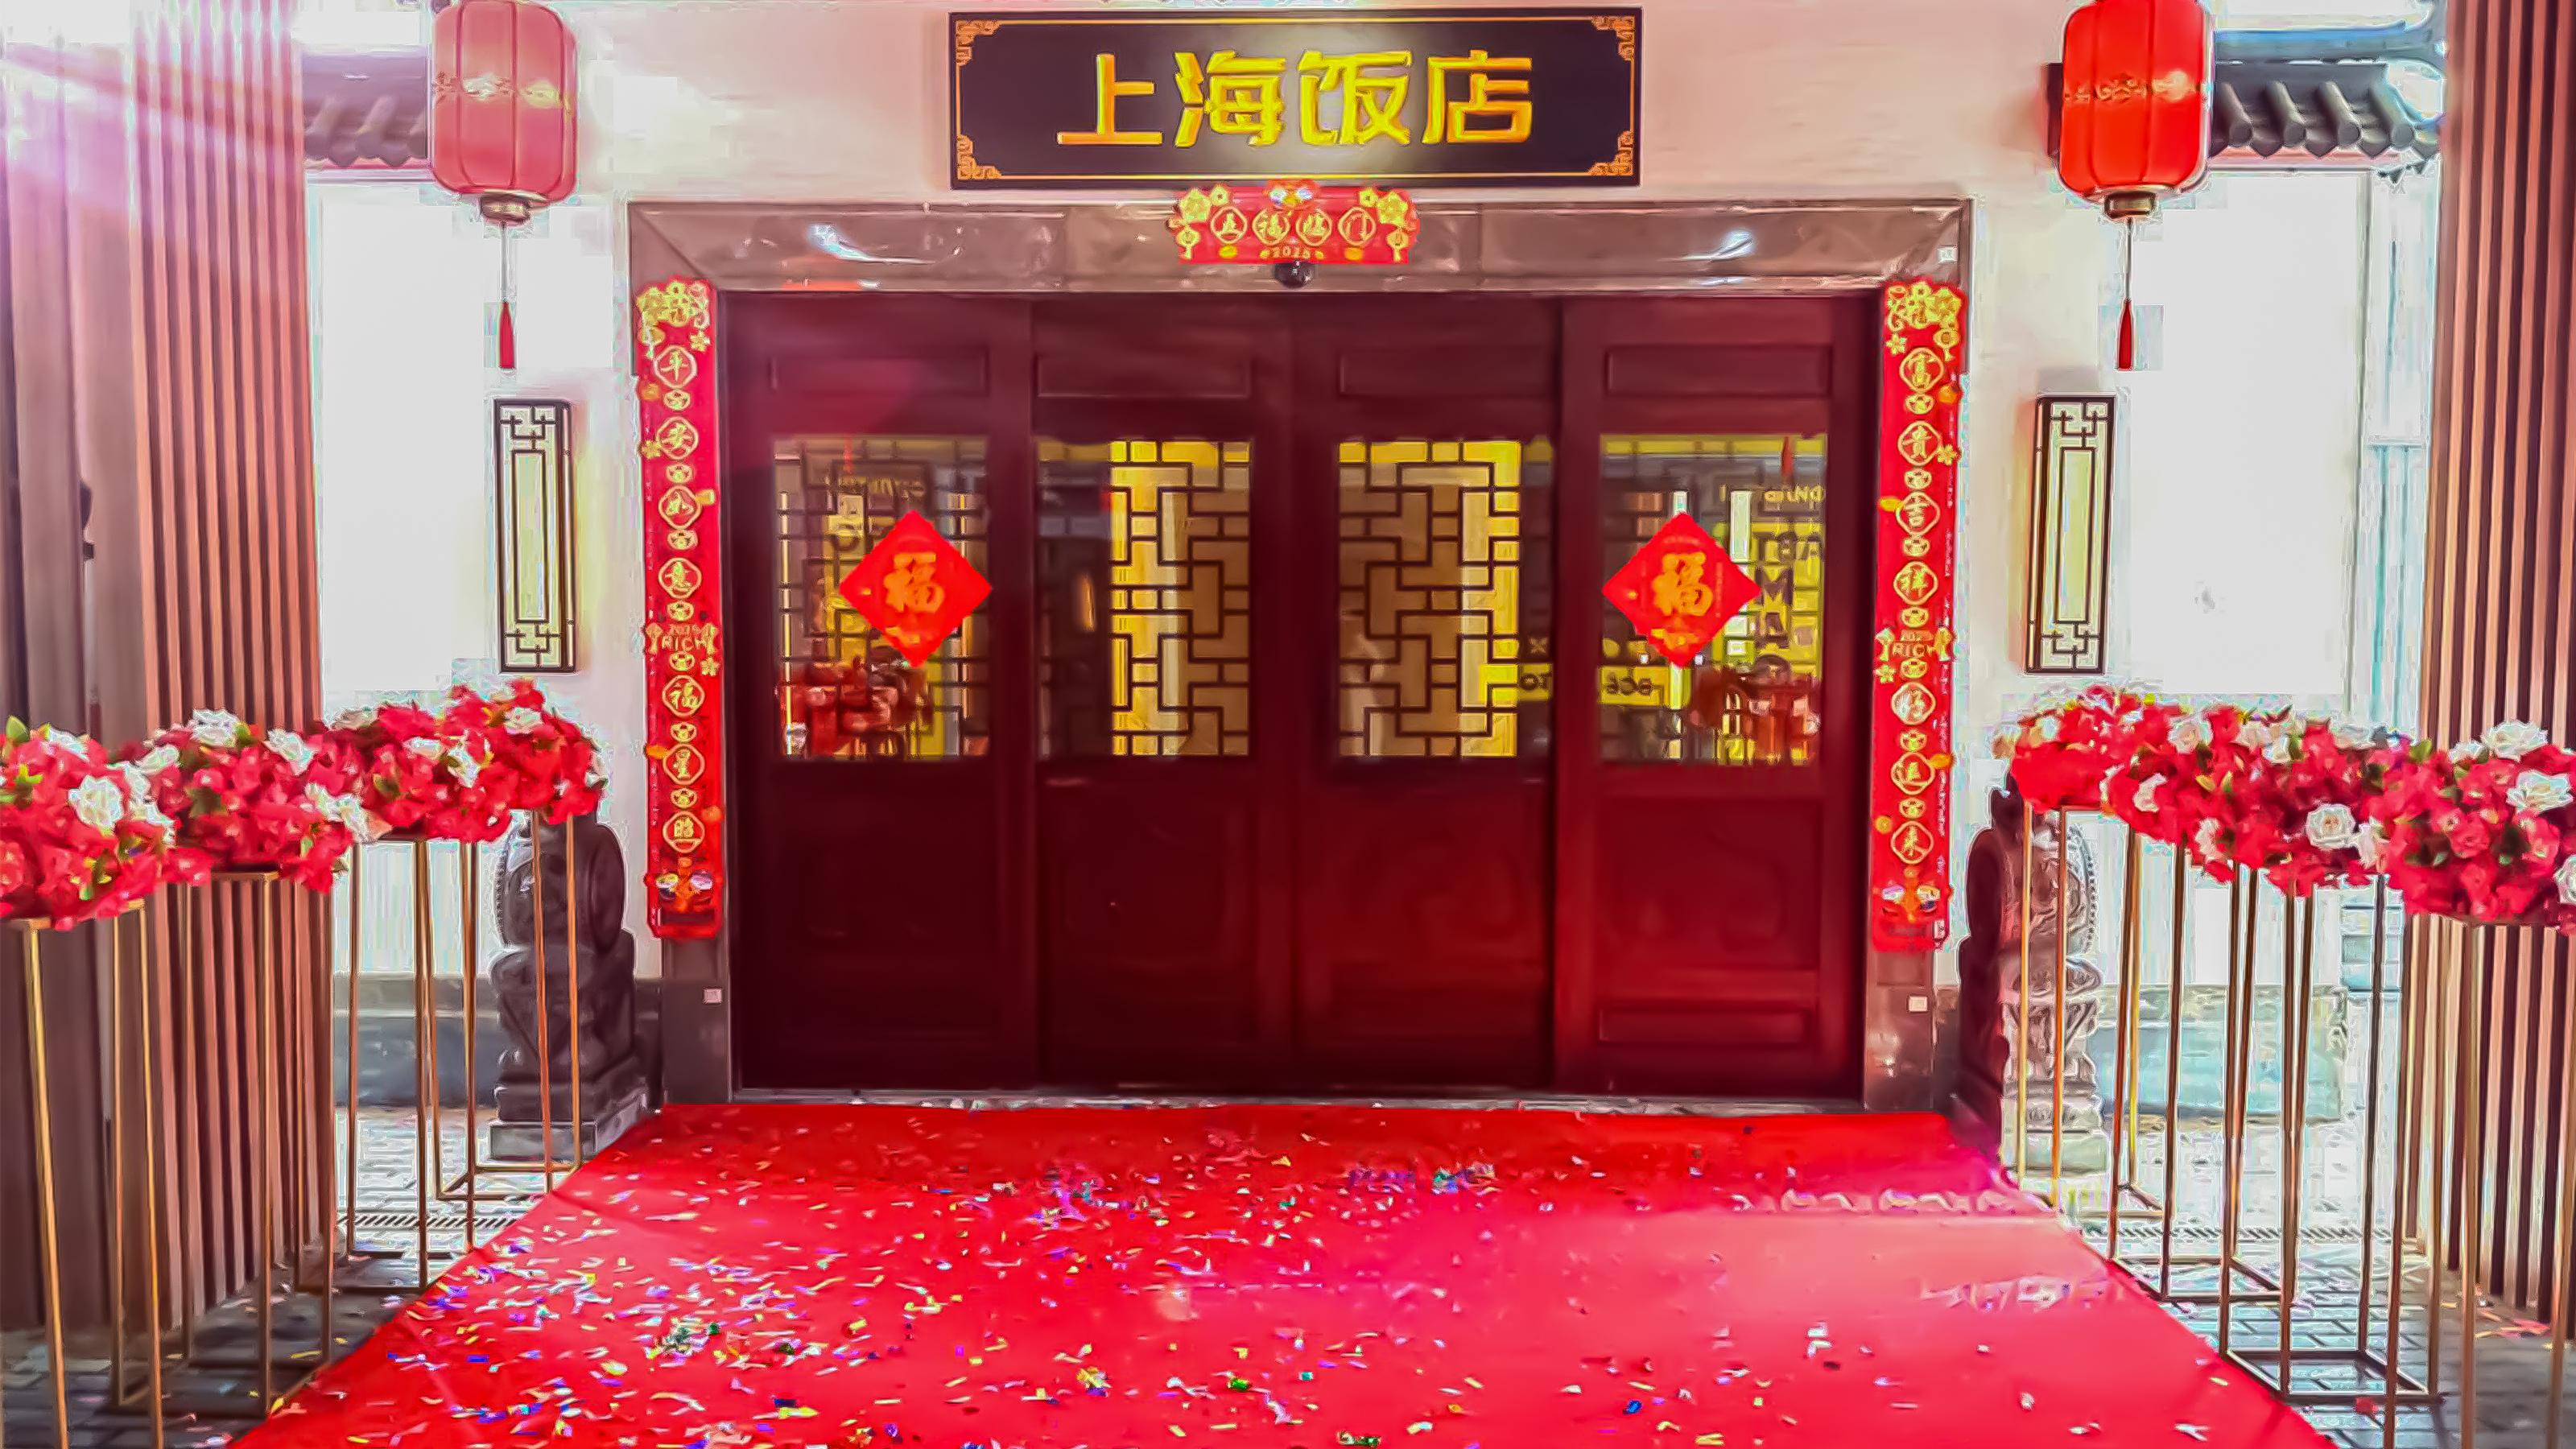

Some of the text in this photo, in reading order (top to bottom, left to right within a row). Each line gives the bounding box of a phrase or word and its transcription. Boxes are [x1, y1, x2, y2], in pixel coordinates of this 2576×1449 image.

[1057, 50, 1532, 147] 上海饭店
[1212, 208, 1373, 244] 五福临门
[883, 551, 944, 613] 福
[1652, 551, 1713, 616] 福
